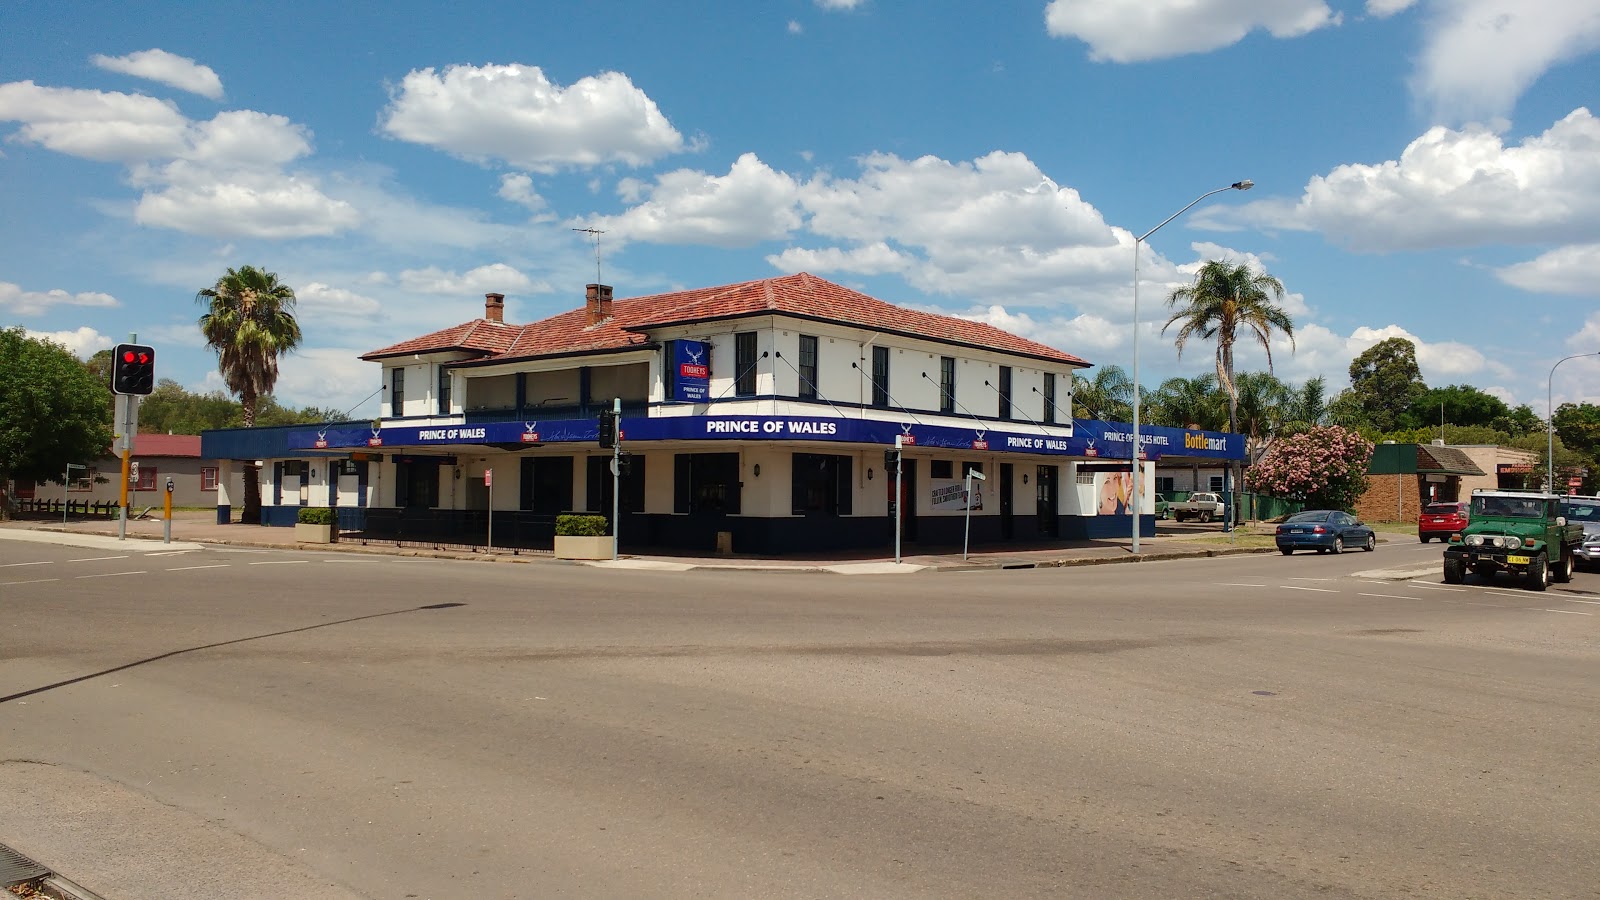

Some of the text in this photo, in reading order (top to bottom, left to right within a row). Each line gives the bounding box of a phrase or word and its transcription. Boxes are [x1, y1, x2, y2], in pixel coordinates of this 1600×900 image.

[684, 366, 705, 375] TOOHEYS
[419, 428, 486, 440] PRINCE OF WALES
[707, 421, 837, 434] PRINCE OF WALES
[1007, 437, 1067, 450] PRINCE OF WALES
[1104, 431, 1169, 445] PRINCE OF ALES HOTEL
[1185, 432, 1227, 451] Bottlemart
